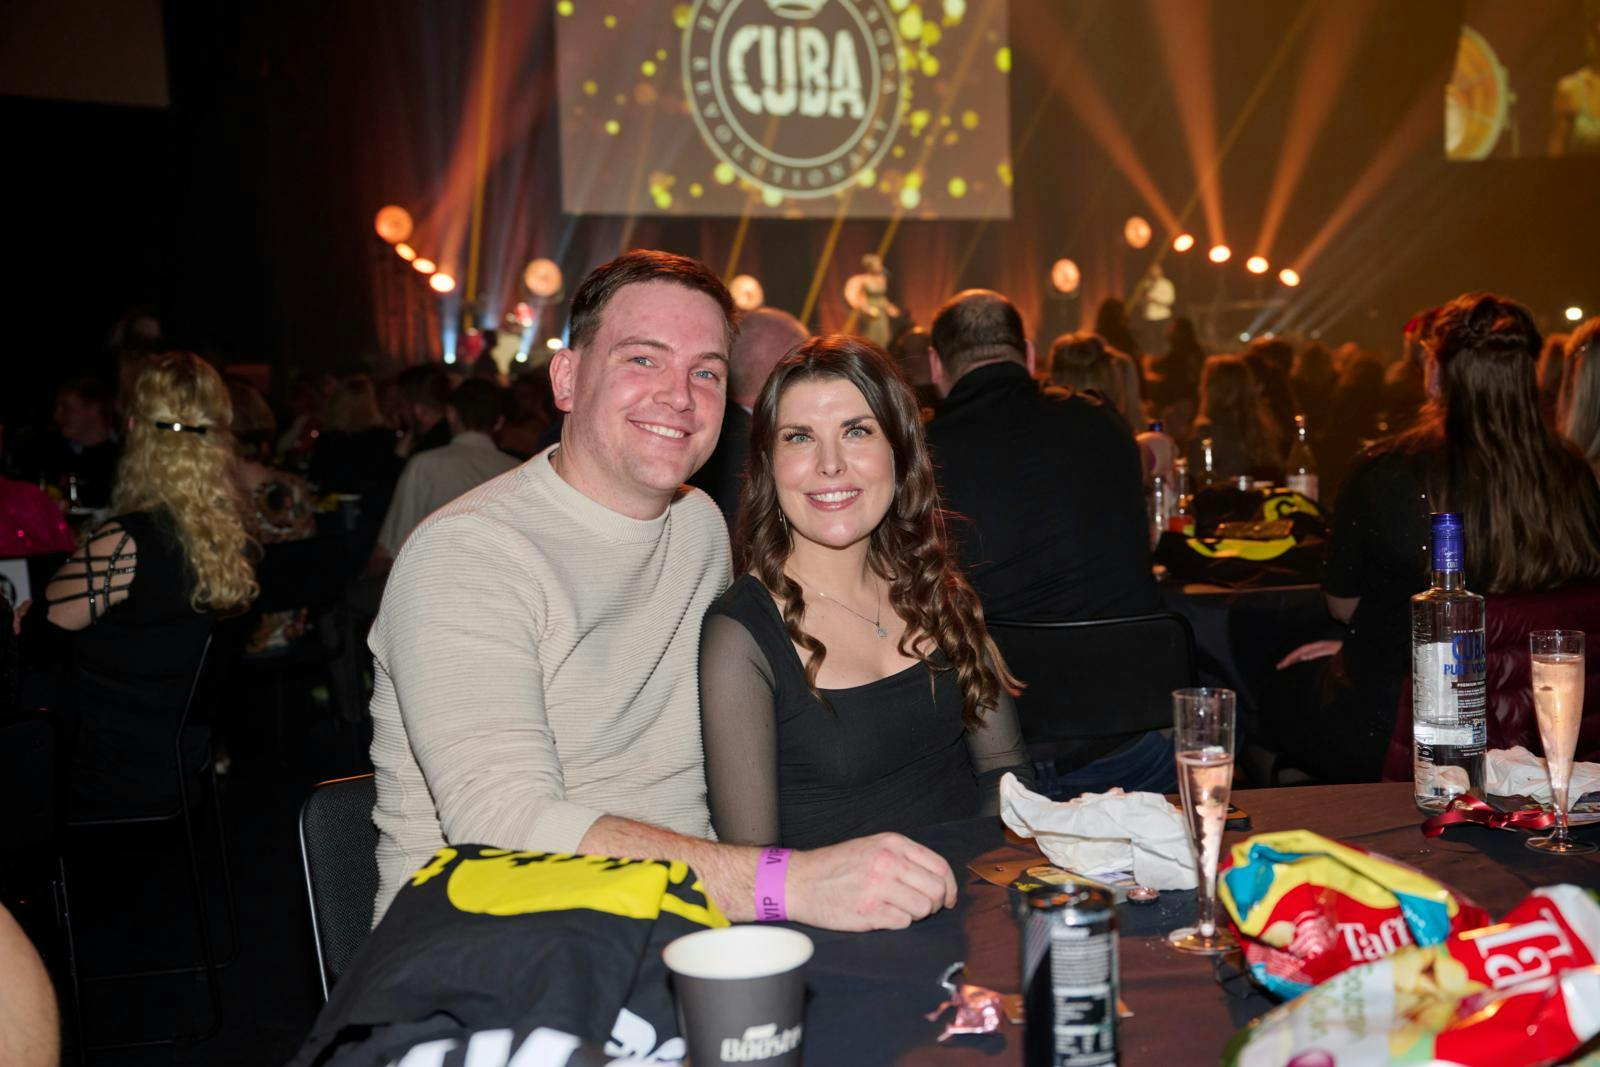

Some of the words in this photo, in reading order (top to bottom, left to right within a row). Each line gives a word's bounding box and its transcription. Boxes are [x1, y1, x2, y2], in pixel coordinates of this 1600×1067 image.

[726, 24, 867, 120] CUBA
[1443, 663, 1470, 676] PURE
[762, 896, 781, 920] VIP
[1336, 914, 1411, 962] Taff
